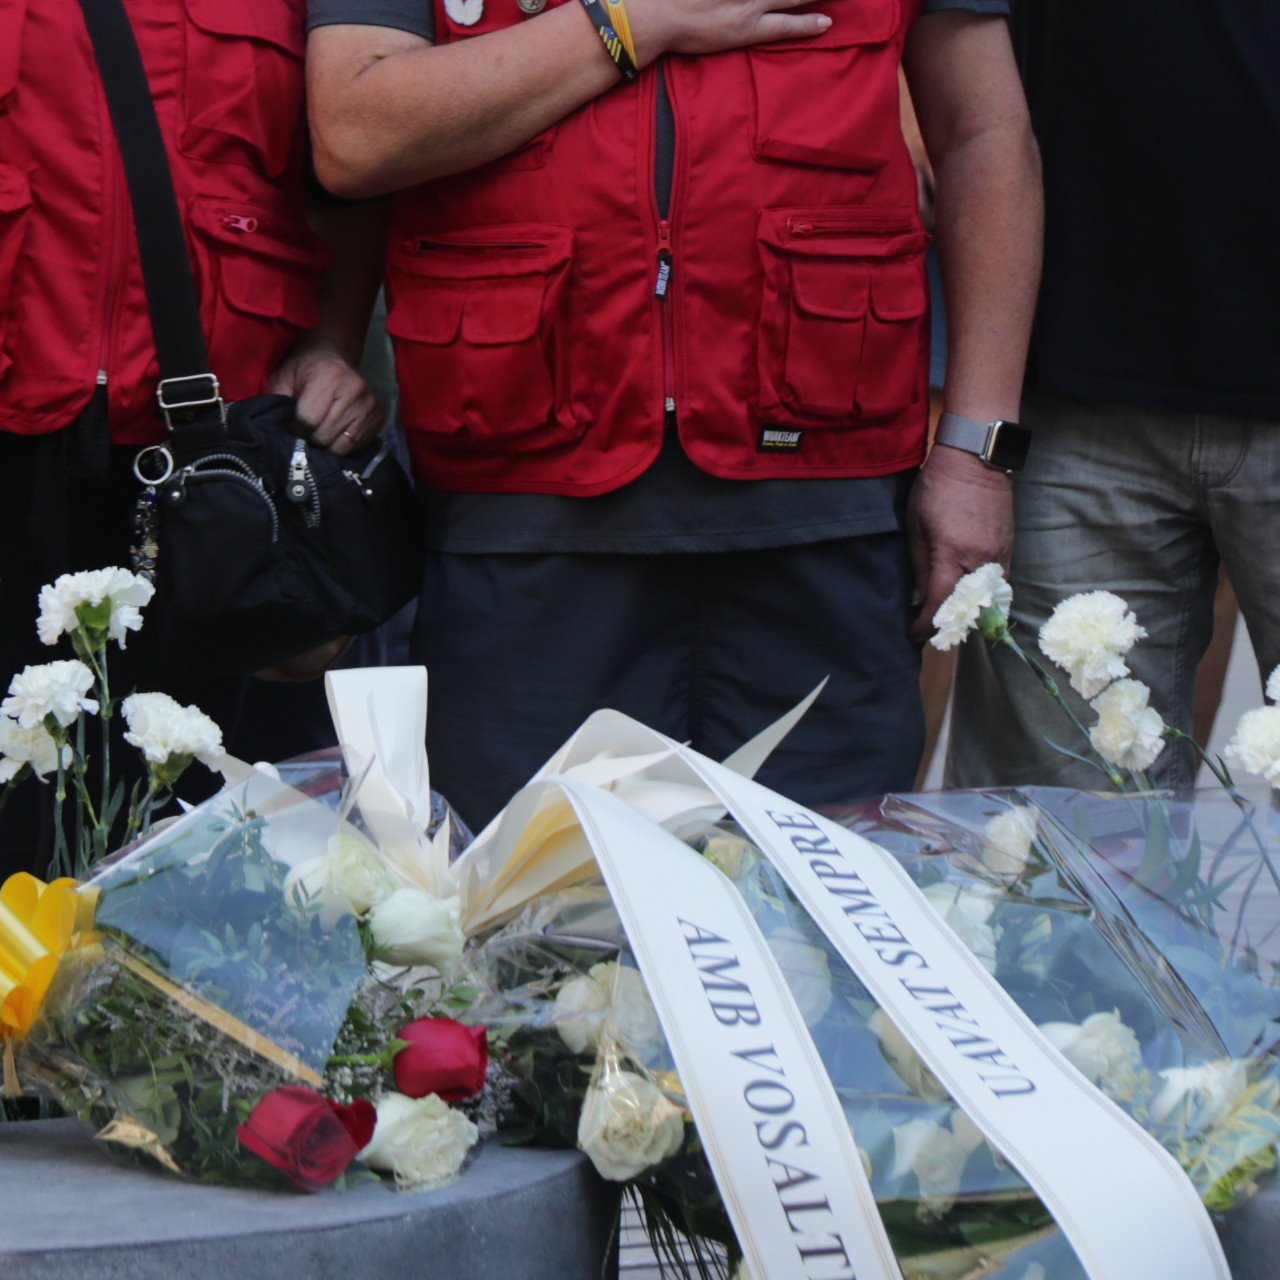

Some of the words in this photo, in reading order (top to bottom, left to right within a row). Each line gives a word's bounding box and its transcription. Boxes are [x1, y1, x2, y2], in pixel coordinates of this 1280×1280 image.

[764, 809, 932, 971] SEMPRE
[676, 916, 762, 1027] AMB
[728, 1043, 857, 1280] VOSALT
